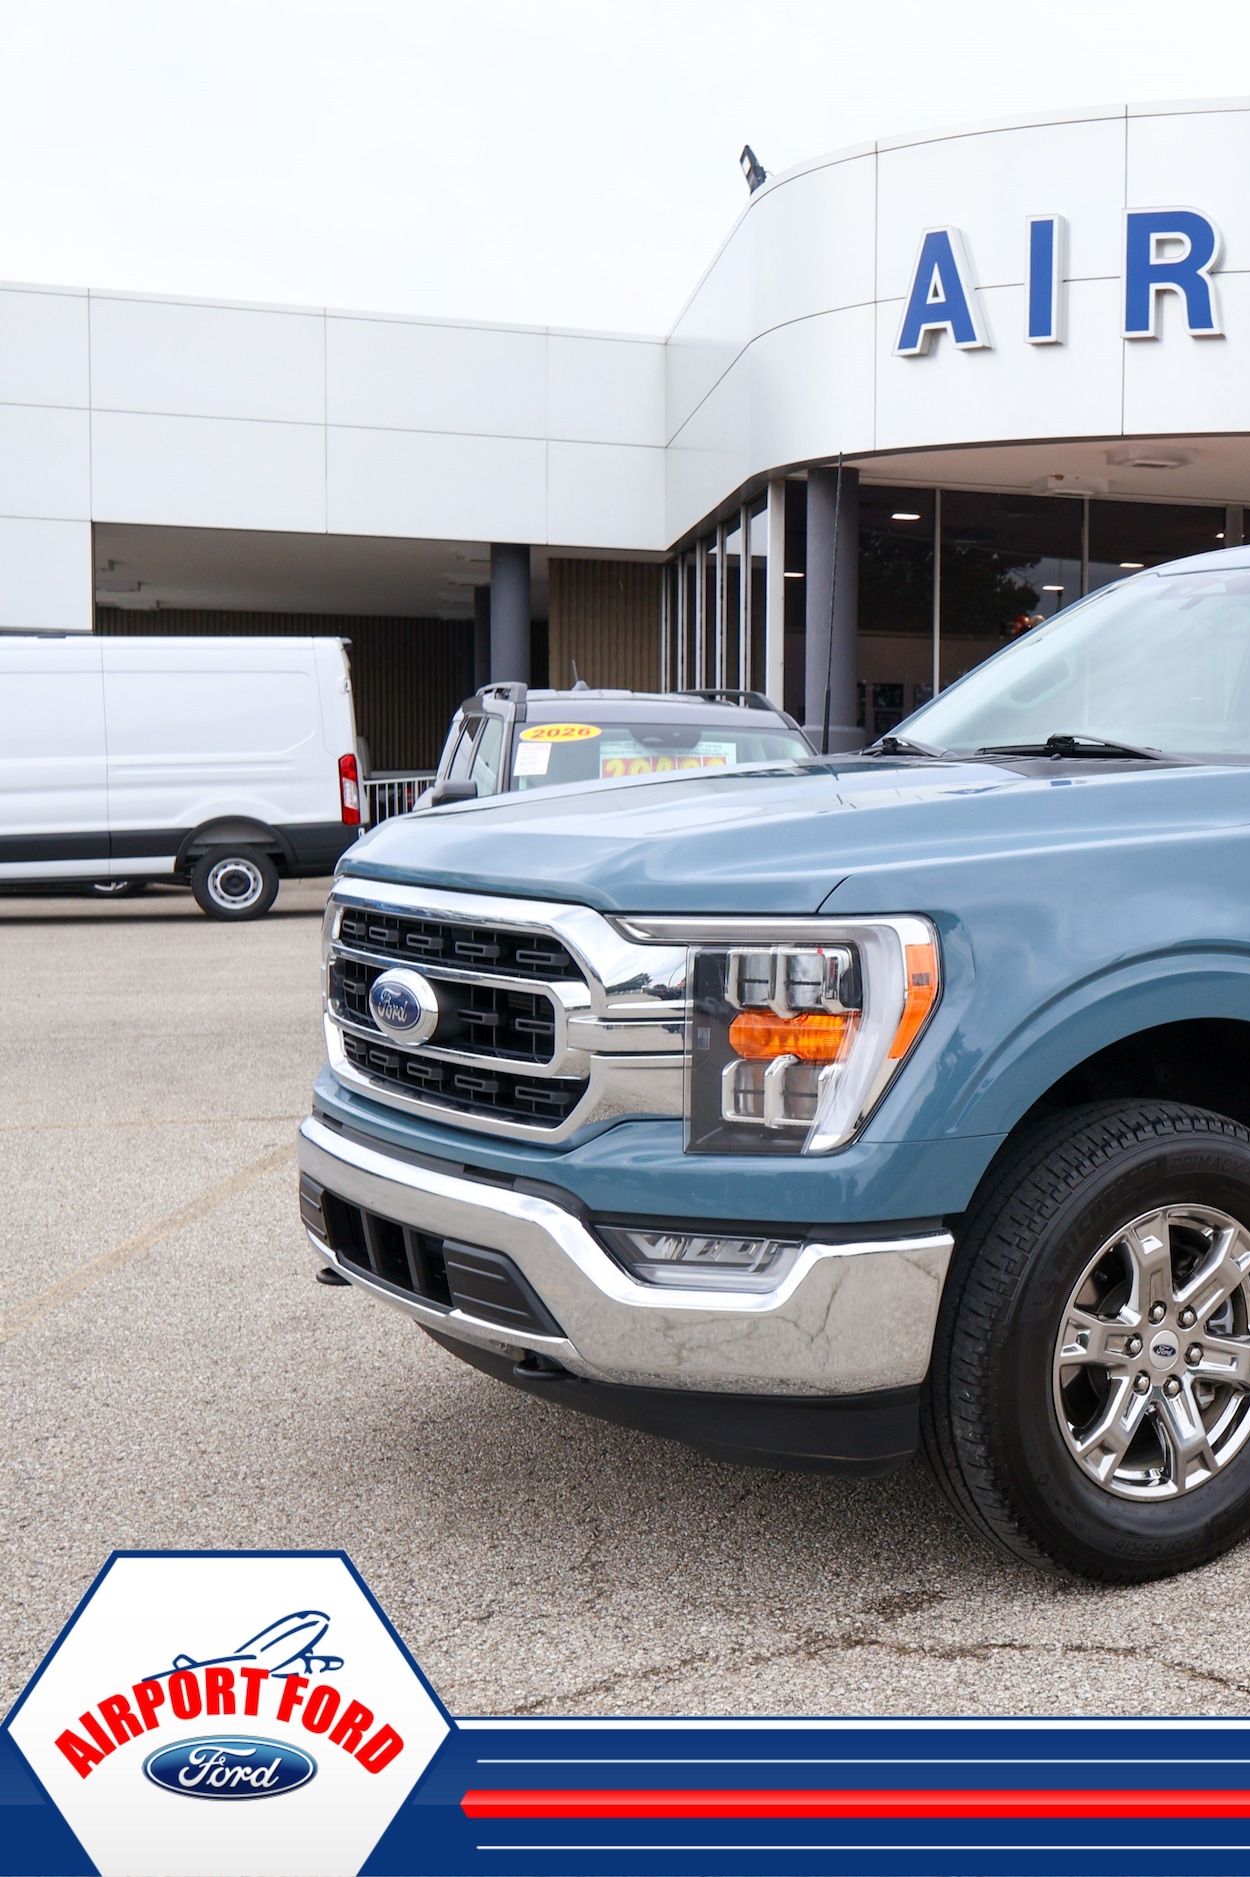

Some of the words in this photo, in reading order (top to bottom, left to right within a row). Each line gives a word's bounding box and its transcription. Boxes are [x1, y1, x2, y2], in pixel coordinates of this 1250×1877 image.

[530, 727, 592, 740] 2026
[378, 988, 408, 1022] Ford
[1172, 1154, 1243, 1173] PRIMACY
